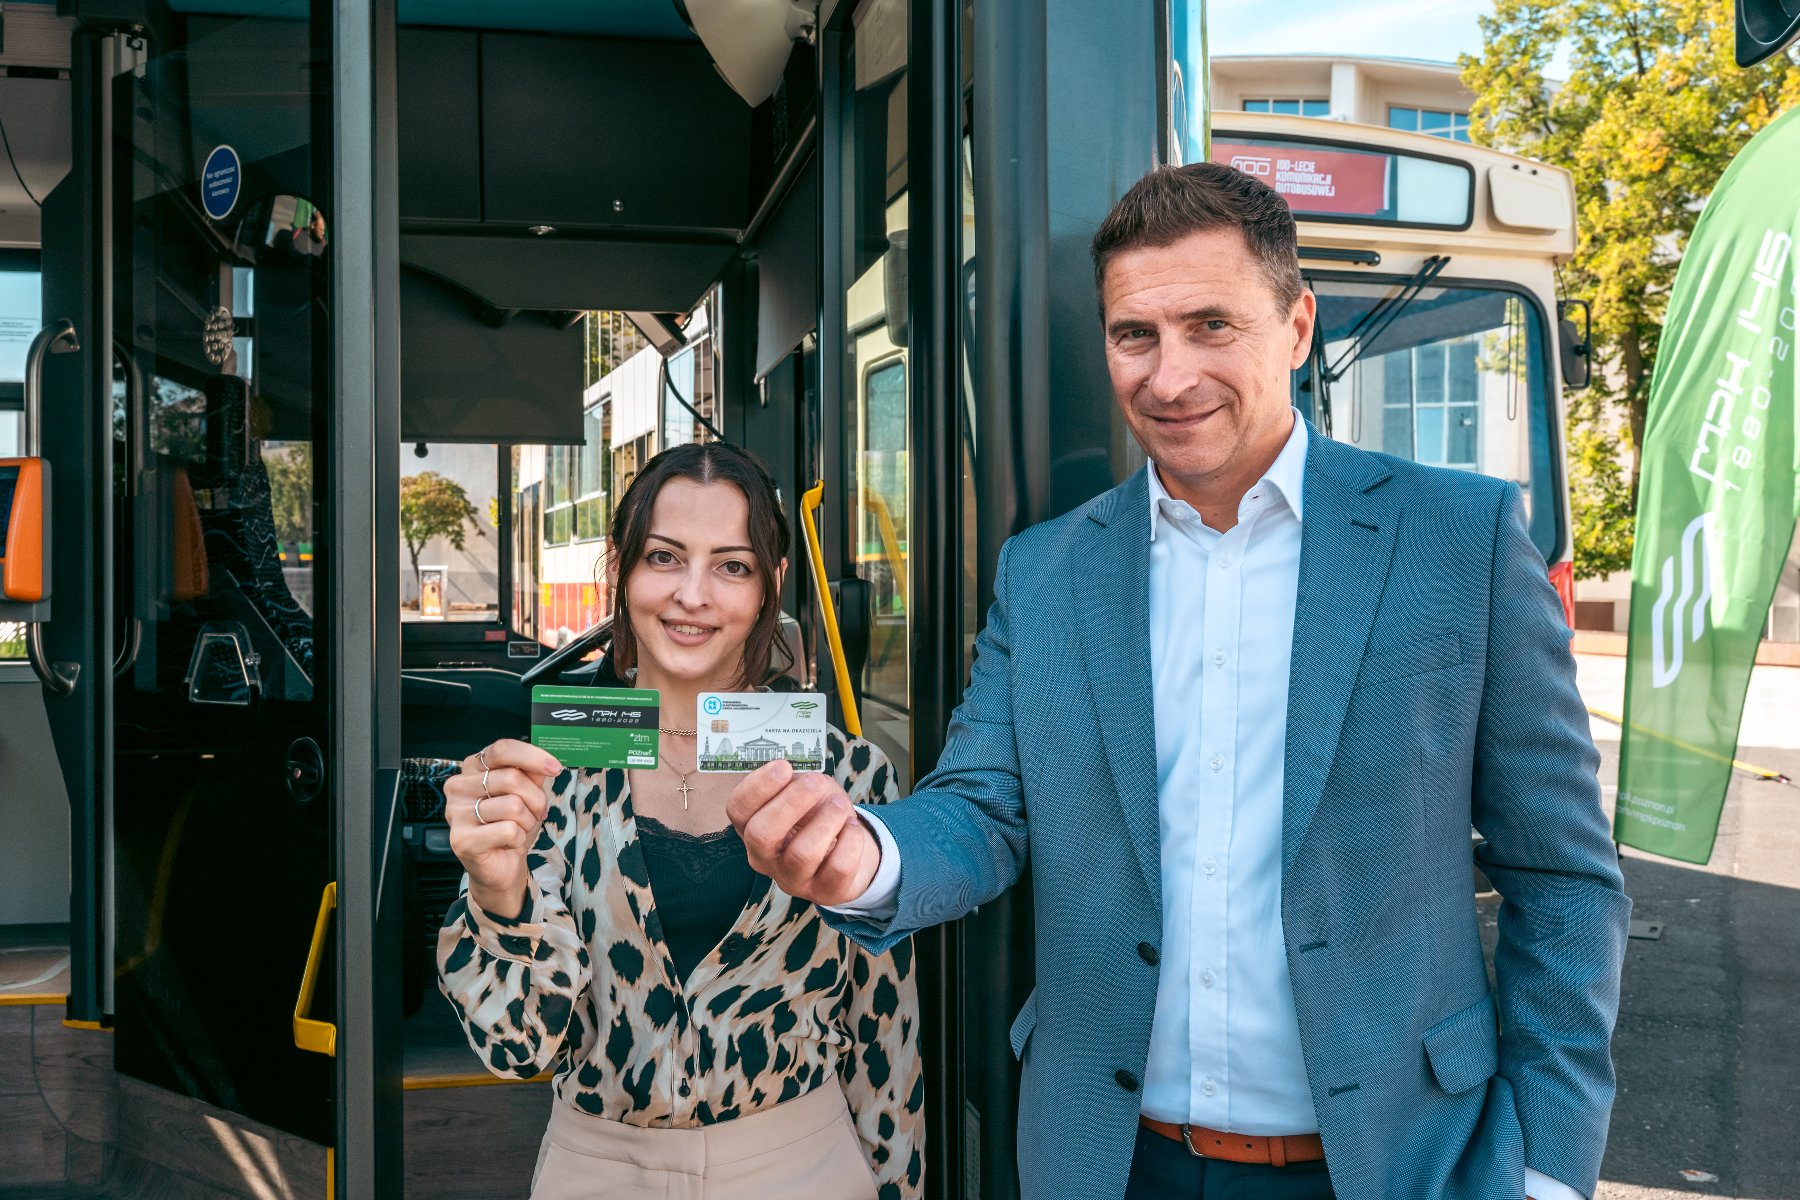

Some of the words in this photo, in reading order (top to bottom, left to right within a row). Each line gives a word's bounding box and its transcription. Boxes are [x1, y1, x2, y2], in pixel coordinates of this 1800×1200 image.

[1276, 159, 1316, 173] 100-LECIE
[1275, 171, 1332, 185] KOMUNIKACJI
[1275, 181, 1335, 197] AUTOBUSOWEJ
[1723, 272, 1796, 493] 1880-20
[1689, 350, 1752, 484] MPK
[633, 733, 650, 742] ztm
[1617, 791, 1676, 814] pk.poznan.pl
[1616, 805, 1686, 832] om/mpkpoznan
